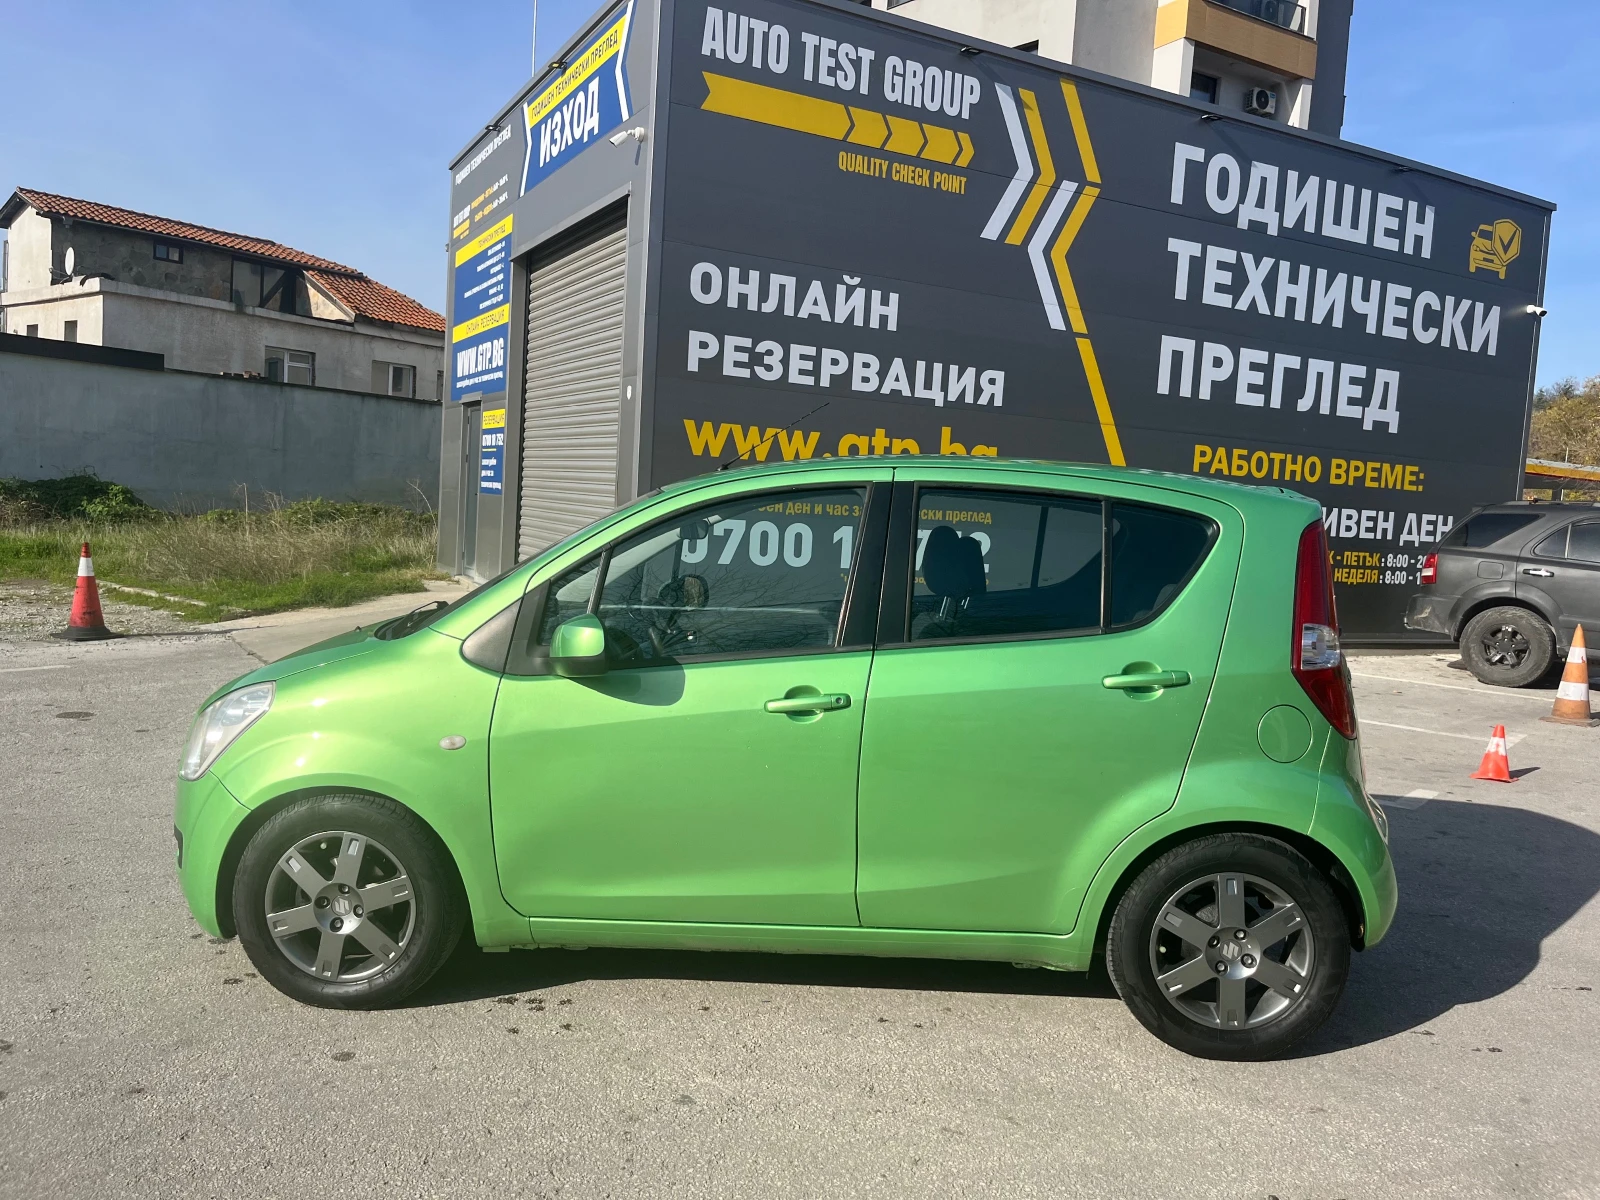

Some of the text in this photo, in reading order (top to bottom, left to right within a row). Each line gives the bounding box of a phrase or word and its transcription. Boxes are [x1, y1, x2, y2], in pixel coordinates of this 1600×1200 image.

[590, 29, 618, 66] ПРЕГЛЕД
[701, 6, 981, 120] AUTO TEST GROUP
[539, 76, 600, 168] ИЗХОД
[838, 151, 967, 195] QUALITY CHECK POINT
[1170, 142, 1436, 259] ГОДИШЕН
[690, 262, 900, 332] ОНЛАЙН
[1167, 237, 1501, 356] ТЕХНИЧЕСКИ
[457, 337, 504, 378] WWW.GTP.BG
[687, 330, 1005, 407] РЕЗЕРВАЦИЯ
[1156, 334, 1400, 434] ПРЕГЛЕД
[1193, 444, 1425, 492] РАБОТНО ВРЕМЕ:
[785, 501, 811, 516] ден
[814, 504, 823, 515] и
[826, 504, 849, 516] час
[852, 505, 862, 516] з
[919, 509, 943, 521] ски
[945, 510, 993, 525] преглед
[1321, 506, 1454, 547] ИВЕН ДЕН
[1384, 570, 1407, 585] 8:00
[1386, 553, 1409, 568] 8:00
